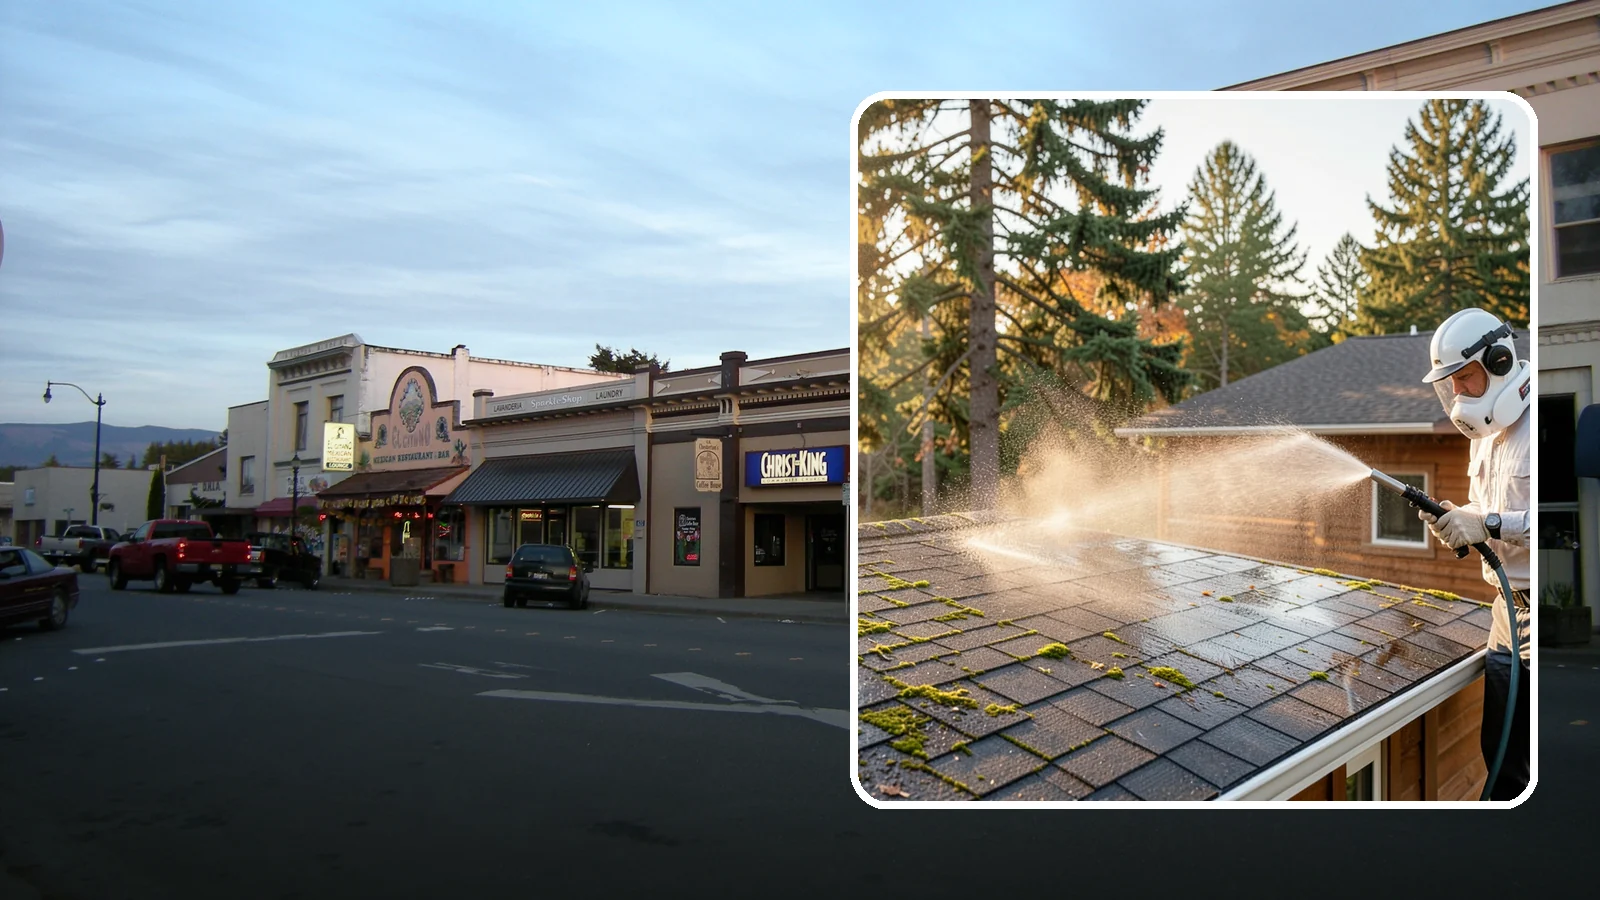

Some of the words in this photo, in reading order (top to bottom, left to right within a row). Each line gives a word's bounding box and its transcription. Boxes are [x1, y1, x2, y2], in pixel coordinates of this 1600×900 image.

[561, 395, 582, 405] Shop
[595, 389, 623, 400] LAUNDRY
[493, 402, 522, 413] LAVANDERIA
[373, 454, 396, 464] MEXICAN
[397, 452, 434, 462] RESTAURANT
[438, 450, 450, 459] BAR
[760, 452, 797, 478] CHRIST
[799, 450, 828, 476] KING
